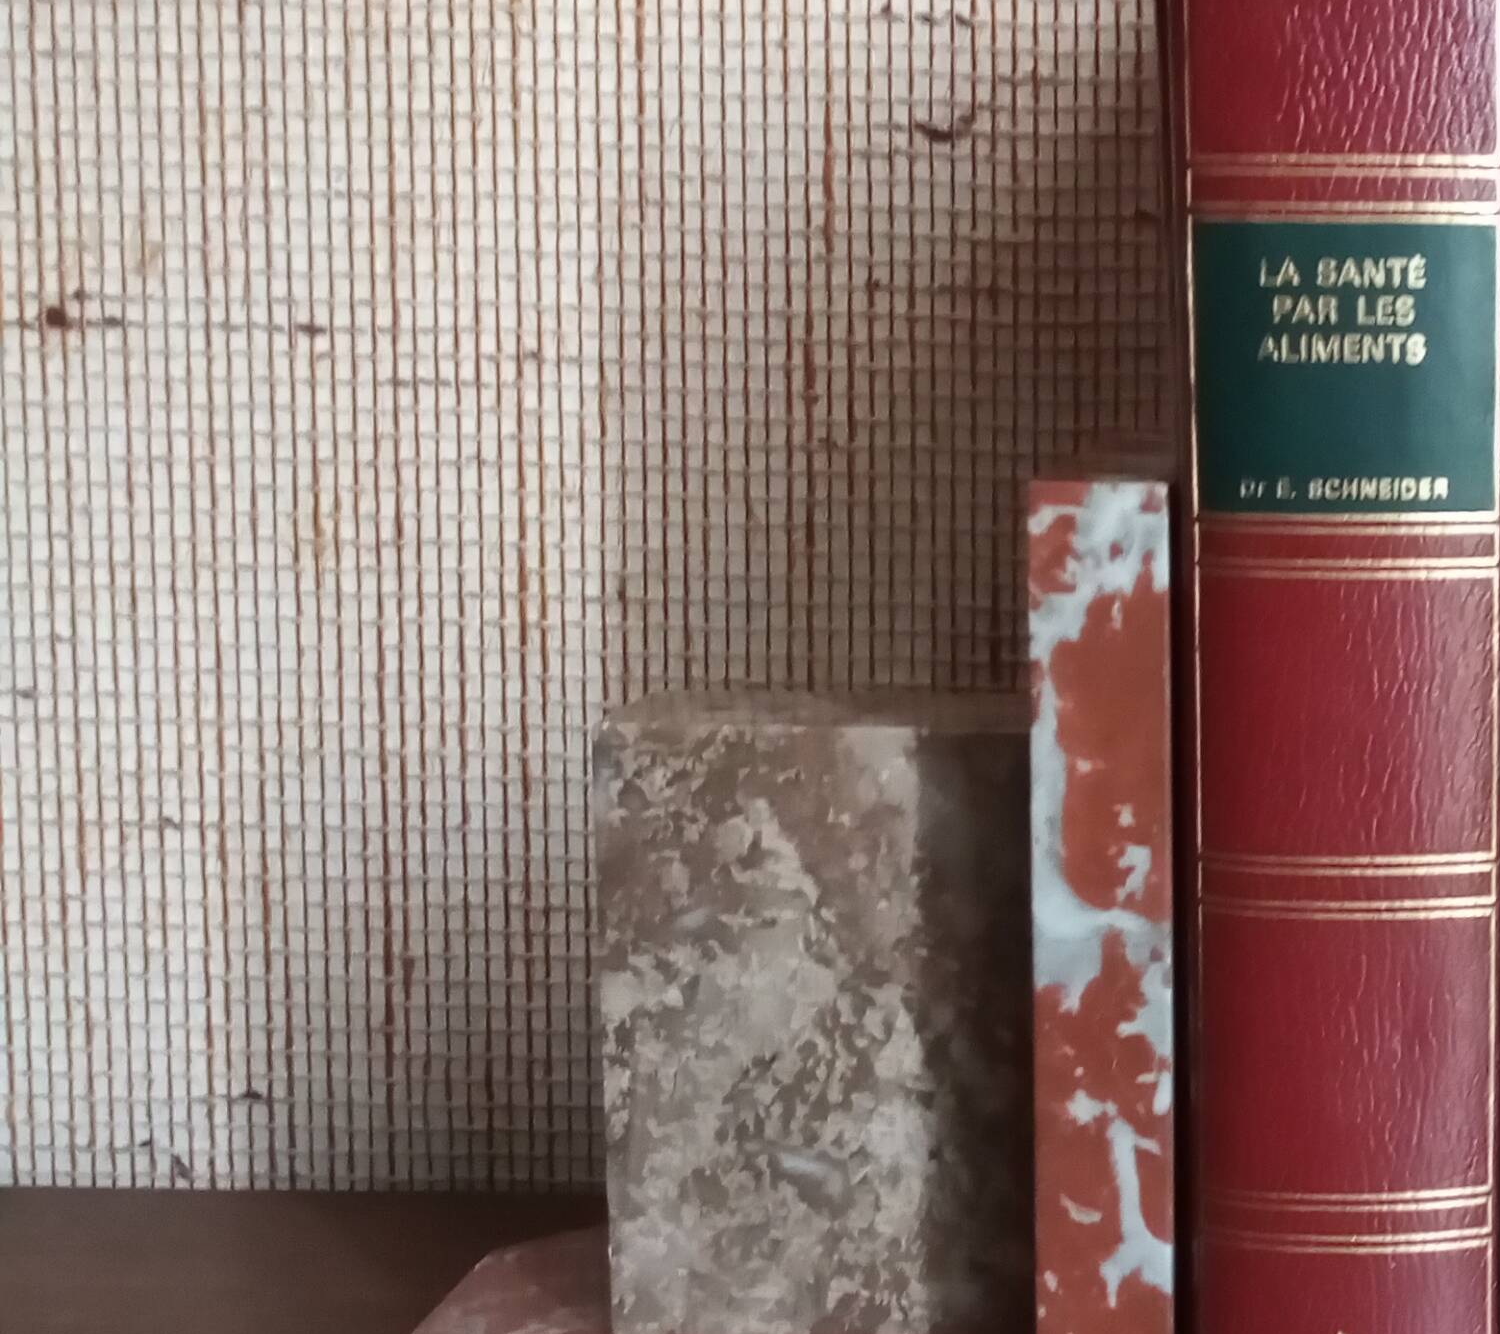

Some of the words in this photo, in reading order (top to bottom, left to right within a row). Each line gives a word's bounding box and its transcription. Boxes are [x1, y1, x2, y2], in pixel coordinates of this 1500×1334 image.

[1259, 256, 1301, 288] LA
[1316, 253, 1428, 289] SANTÉ
[1272, 294, 1338, 325] PAR
[1357, 294, 1416, 326] LES
[1257, 332, 1428, 365] ALIMENTS
[1308, 477, 1449, 501] SCHNEIDER
